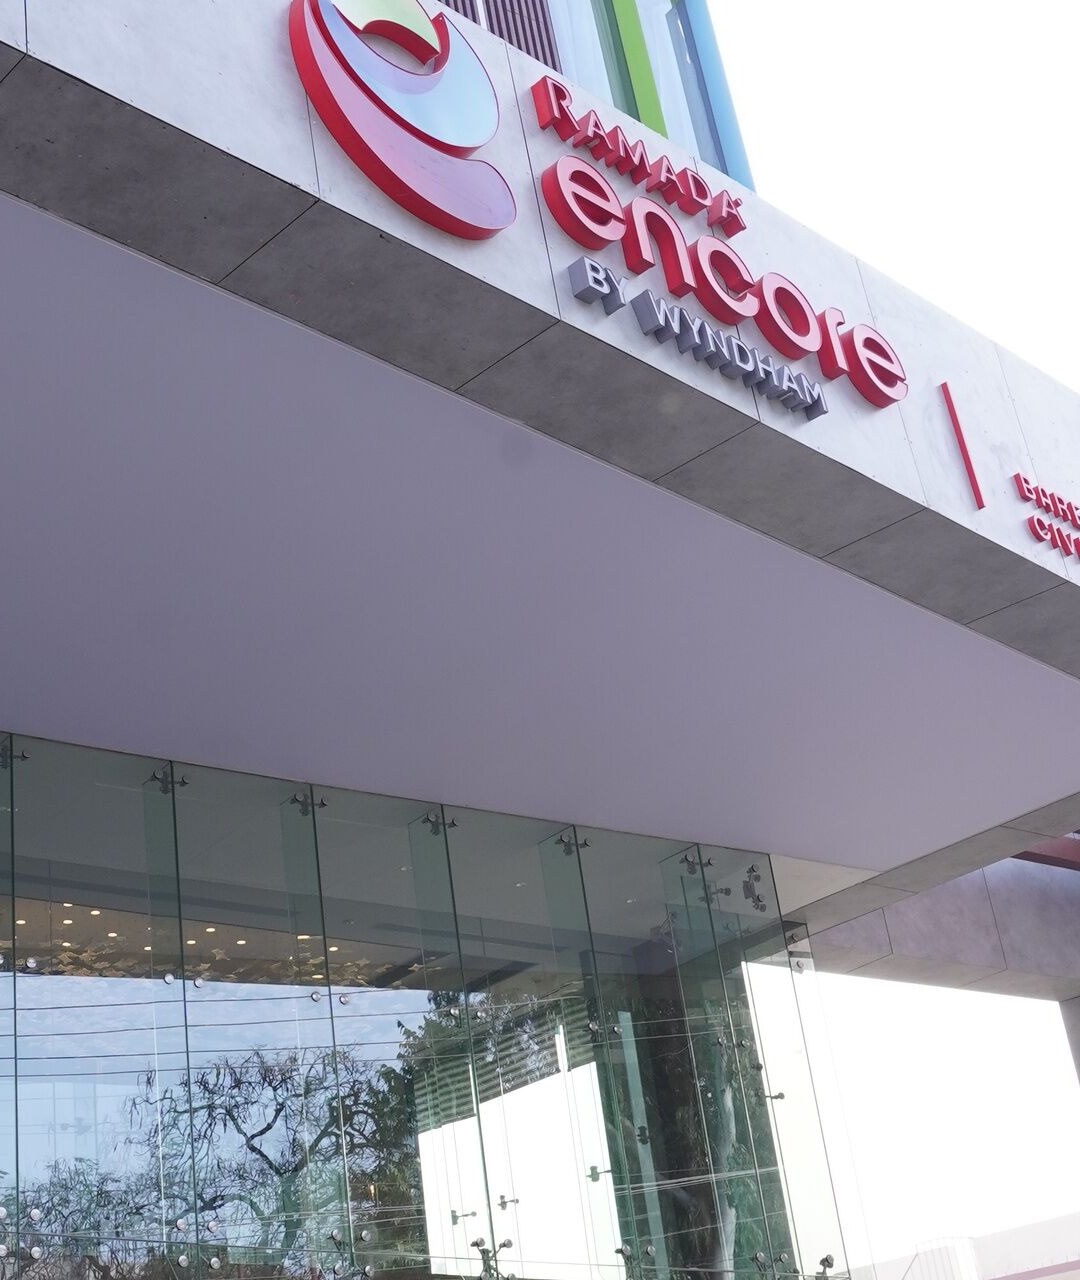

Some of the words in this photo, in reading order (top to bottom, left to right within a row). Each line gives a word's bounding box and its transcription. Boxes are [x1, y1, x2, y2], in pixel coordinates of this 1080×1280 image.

[532, 75, 747, 238] RAMADA
[541, 155, 908, 408] encore
[568, 256, 628, 317] BY
[631, 289, 829, 420] WYNDHAM
[1026, 515, 1080, 563] CIV
